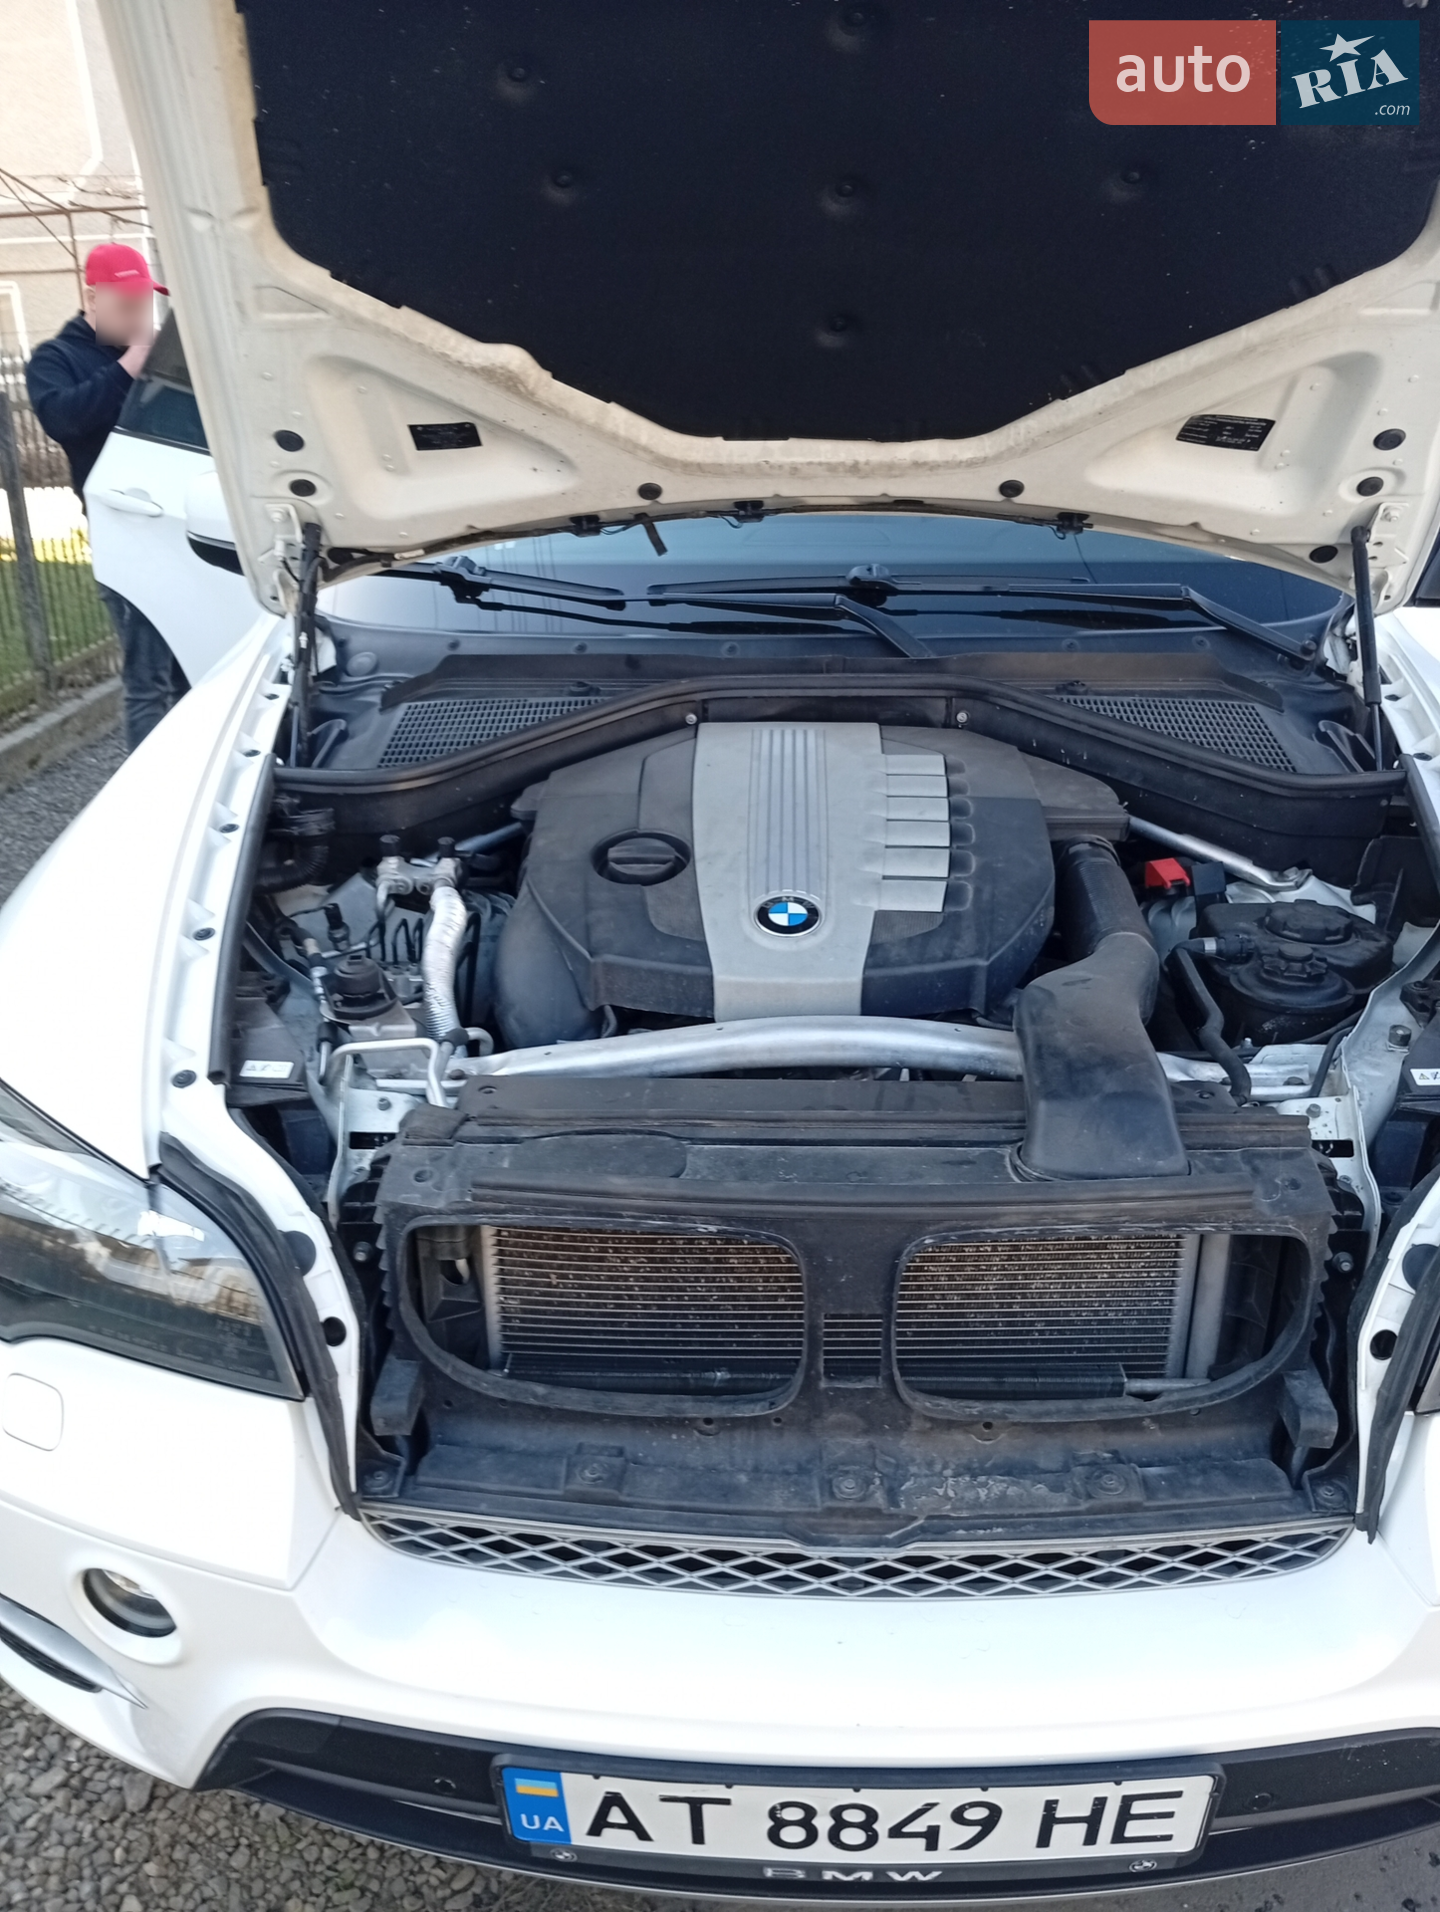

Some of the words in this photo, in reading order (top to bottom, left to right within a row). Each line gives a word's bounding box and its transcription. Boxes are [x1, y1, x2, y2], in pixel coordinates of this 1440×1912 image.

[519, 1809, 565, 1834] UA
[585, 1790, 733, 1846] AT
[765, 1800, 1003, 1853] 8849
[1035, 1789, 1185, 1849] HE
[762, 1866, 943, 1883] BMW
